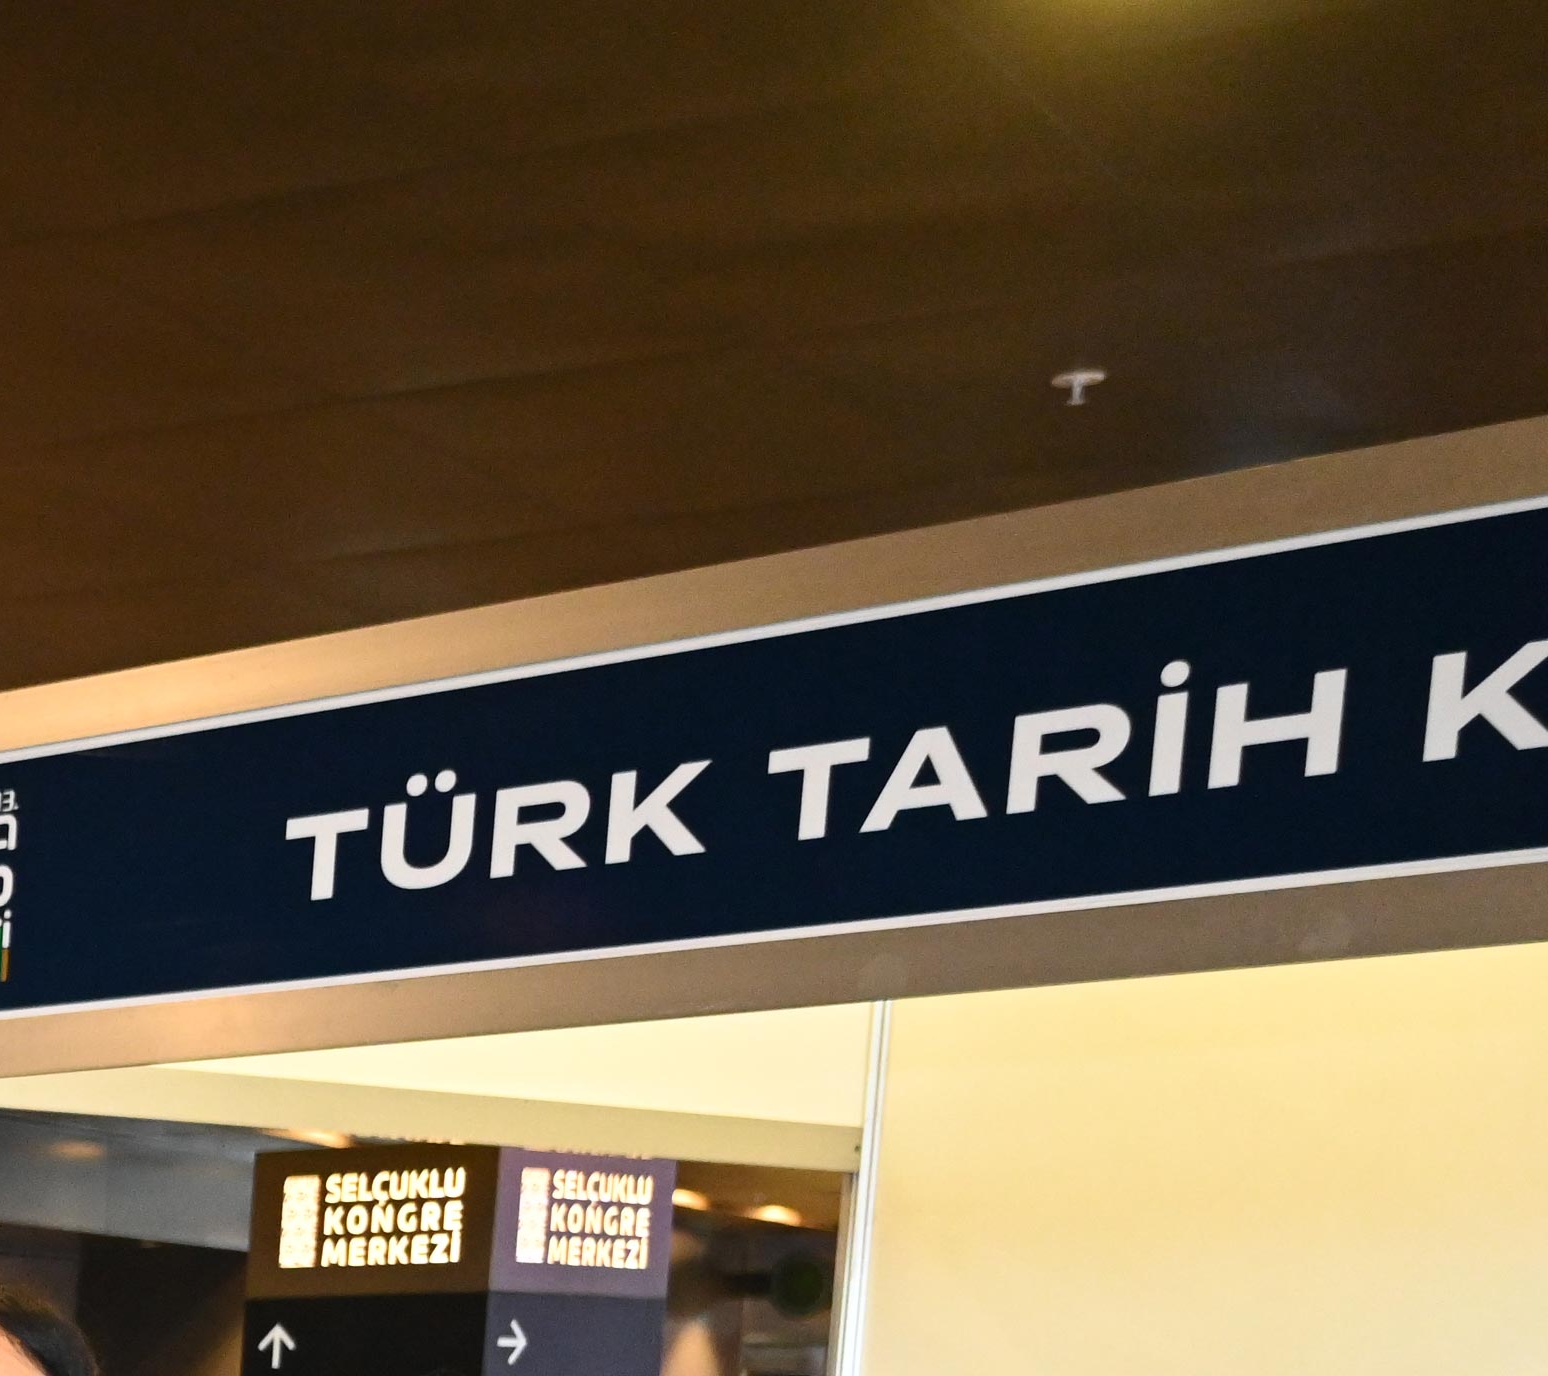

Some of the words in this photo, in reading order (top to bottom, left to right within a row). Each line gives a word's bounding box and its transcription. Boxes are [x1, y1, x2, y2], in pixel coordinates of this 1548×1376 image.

[285, 760, 713, 901] TÜRK
[768, 660, 1348, 840] TARİH
[324, 1167, 466, 1207] SELÇUKLU
[552, 1169, 654, 1207] SELÇUKLU
[322, 1200, 464, 1236] KONGRE
[549, 1202, 652, 1238] KONGRE
[320, 1230, 462, 1268] MERKEZİ
[547, 1234, 649, 1270] MERKEZİ
